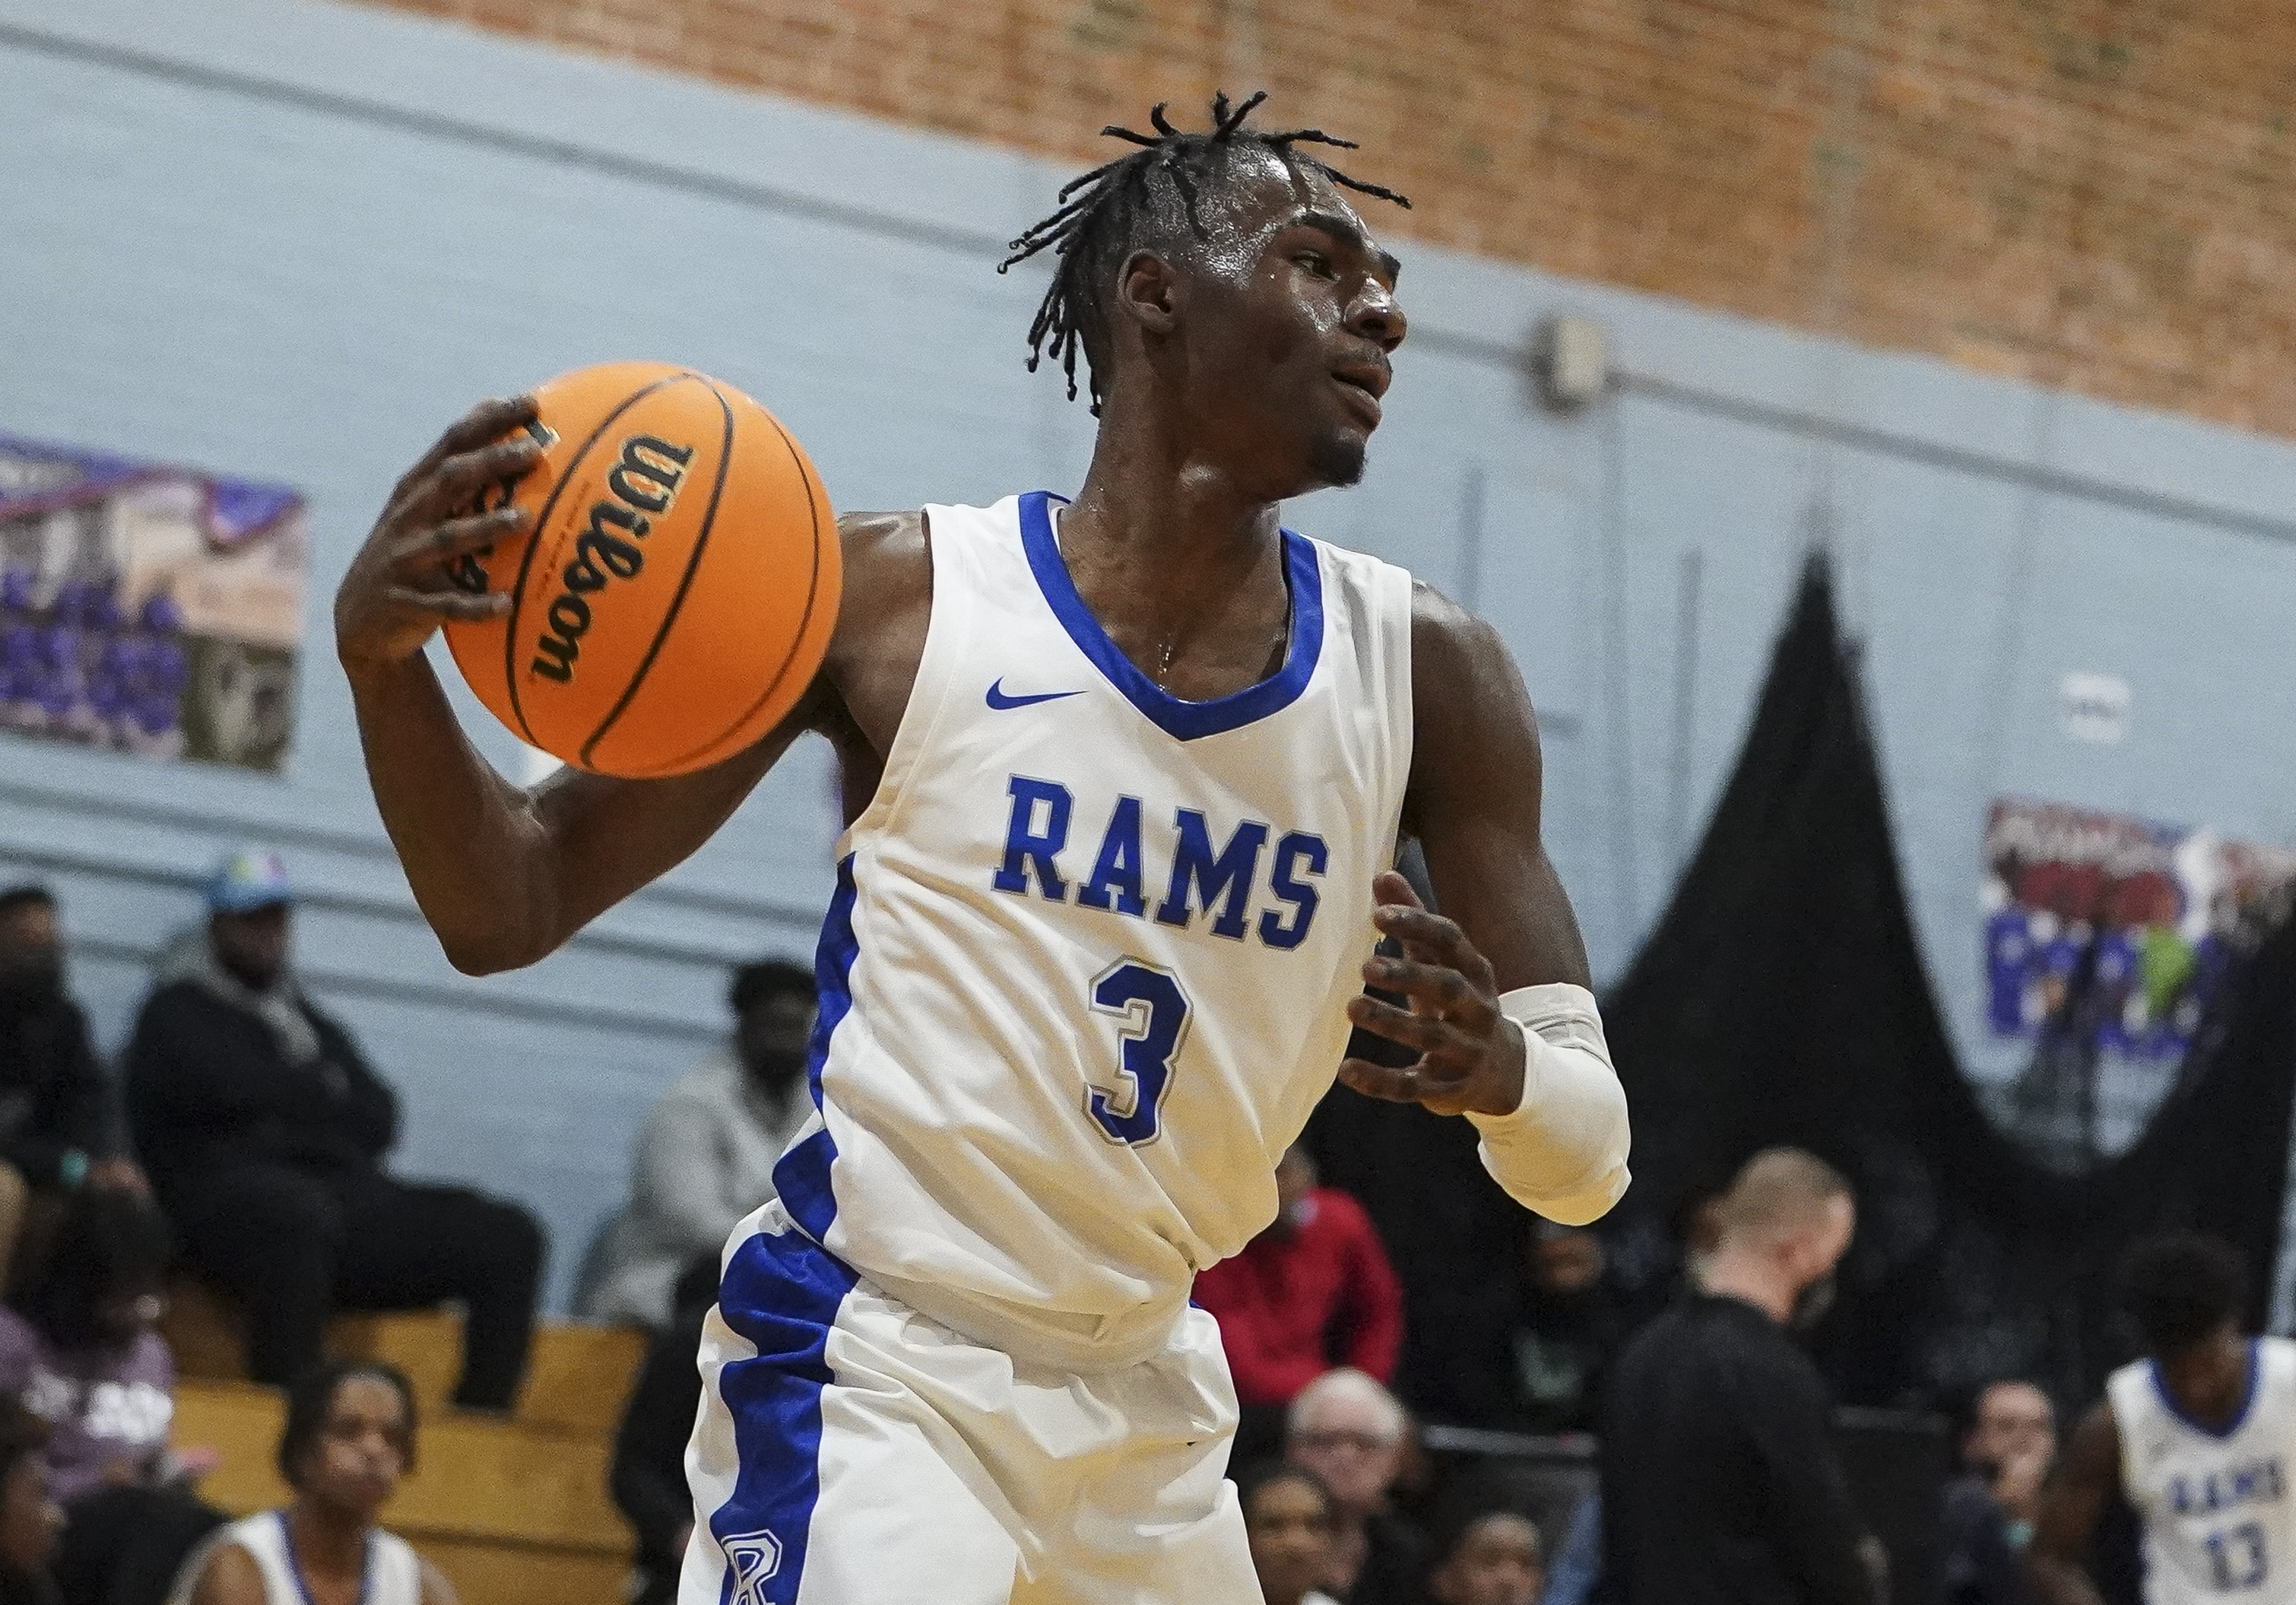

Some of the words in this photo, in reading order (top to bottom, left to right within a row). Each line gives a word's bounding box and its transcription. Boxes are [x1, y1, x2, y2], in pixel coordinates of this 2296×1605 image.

[532, 434, 696, 683] Wilson
[991, 773, 1329, 951] RAMS
[1081, 955, 1194, 1149] 3
